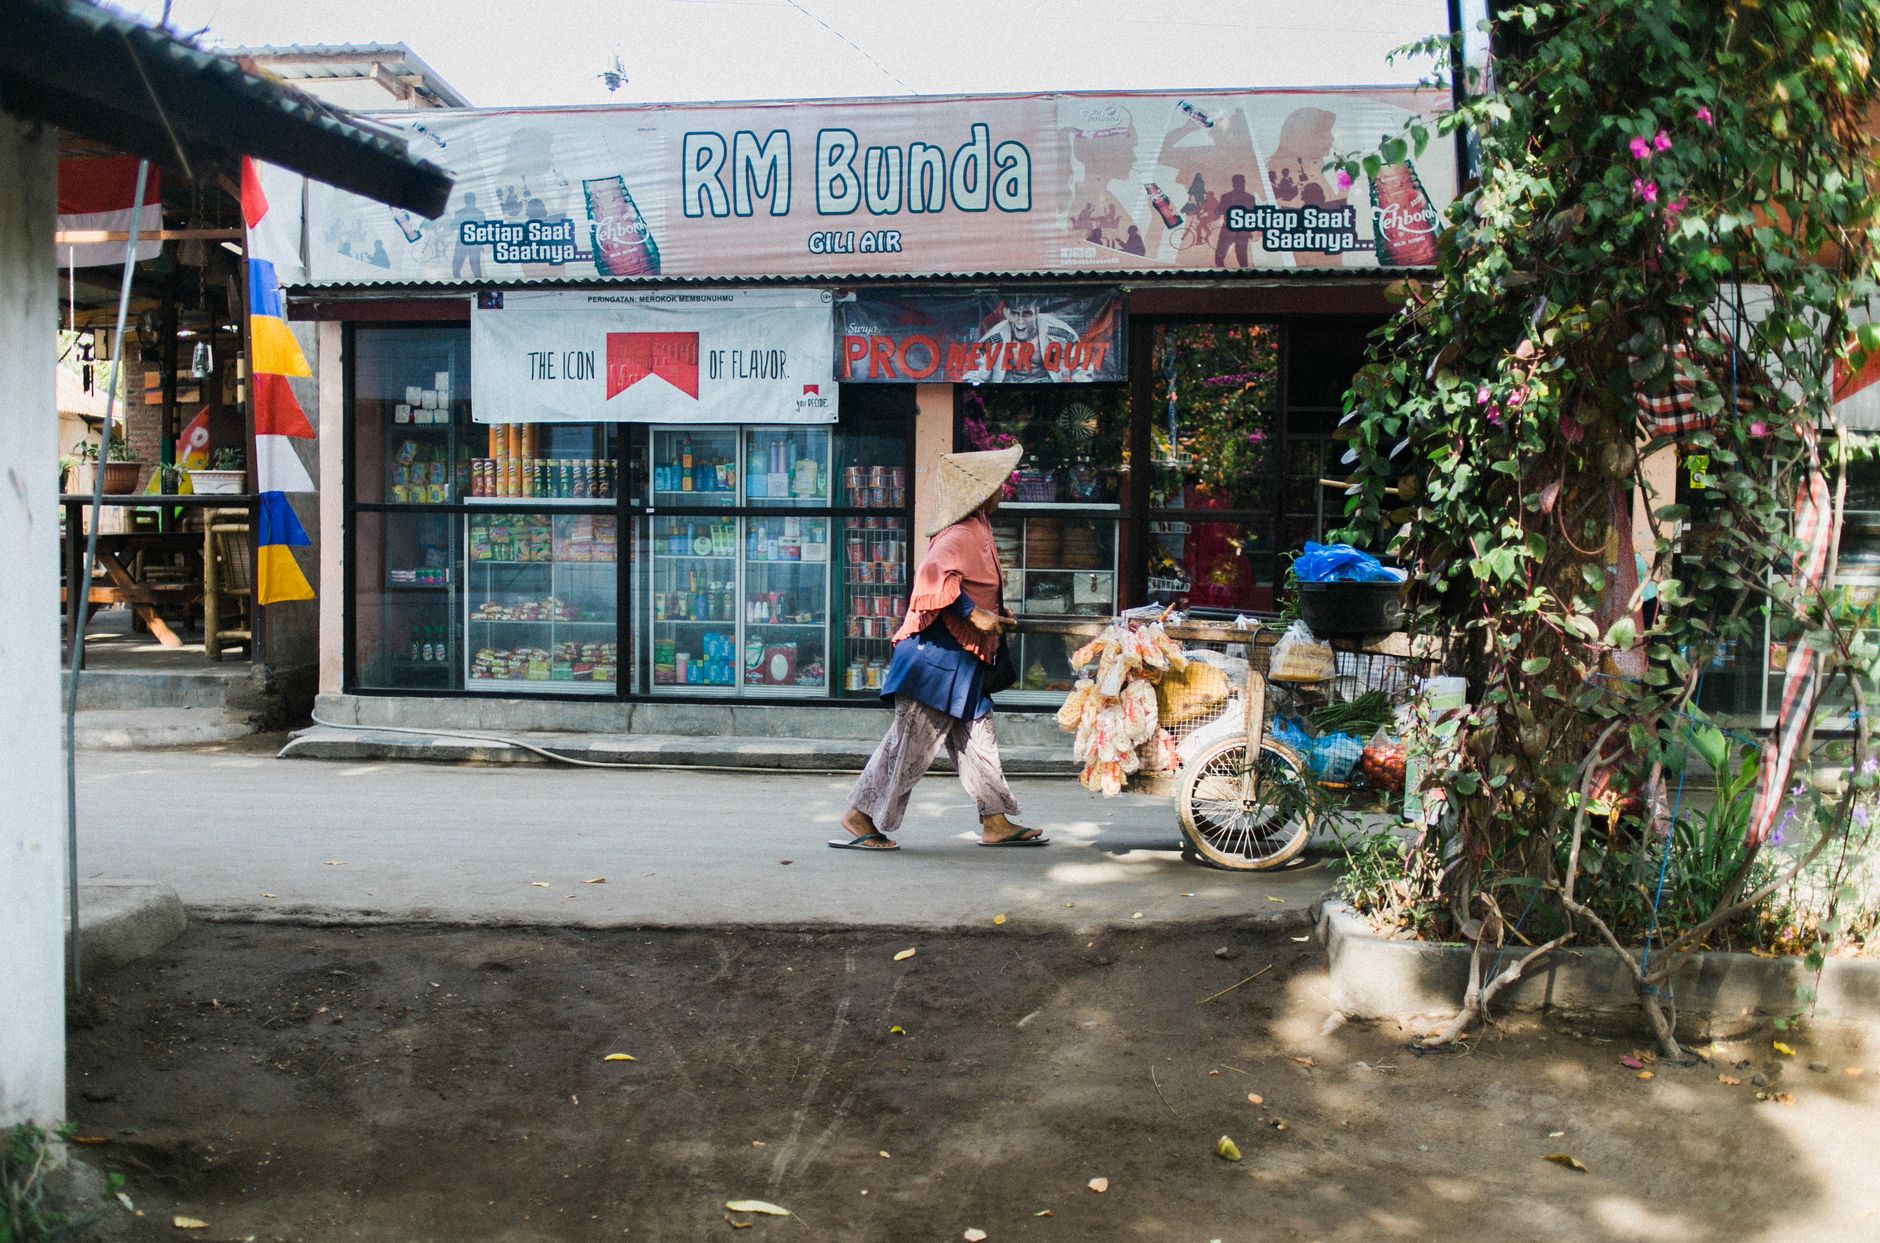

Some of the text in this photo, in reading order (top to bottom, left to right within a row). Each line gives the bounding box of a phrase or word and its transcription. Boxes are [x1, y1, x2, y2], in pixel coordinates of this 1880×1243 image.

[682, 123, 1032, 217] RM Bunda
[1230, 207, 1352, 231] Setiap Saat
[1372, 203, 1440, 241] Tehbotol
[464, 221, 571, 243] Setiap Saat
[808, 230, 902, 253] GILI AIR
[1266, 229, 1375, 251] Saatnya...
[496, 242, 594, 263] Saatnya...
[678, 295, 734, 303] MEMBUNUHMU
[848, 322, 881, 335] Surya
[528, 351, 556, 381] THE
[562, 350, 595, 380] ICON
[709, 350, 726, 380] OF
[731, 349, 790, 380] FLAVOR.
[841, 334, 1110, 379] PRO NEVER QUIT
